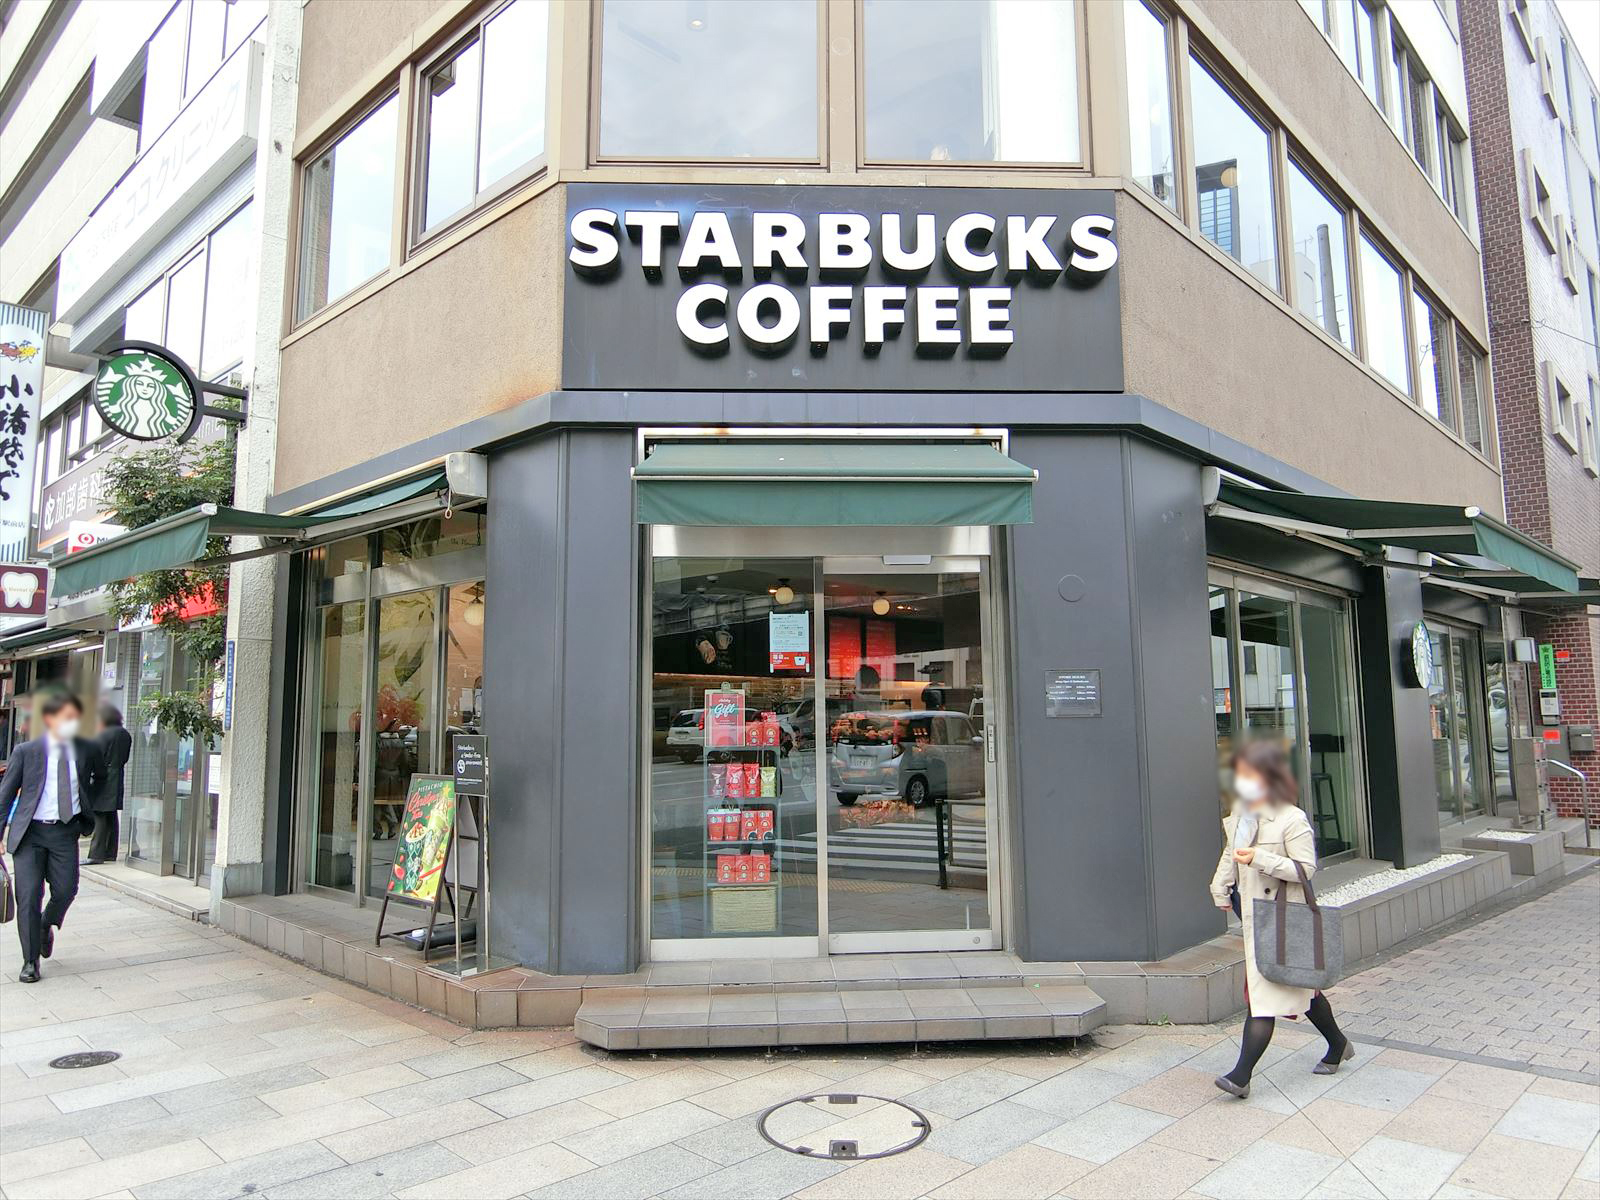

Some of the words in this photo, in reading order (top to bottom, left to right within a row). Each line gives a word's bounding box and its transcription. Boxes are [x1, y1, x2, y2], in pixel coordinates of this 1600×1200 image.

[568, 208, 1120, 275] STARBUCKS
[675, 282, 1014, 346] COFFEE
[714, 702, 735, 719] Gift
